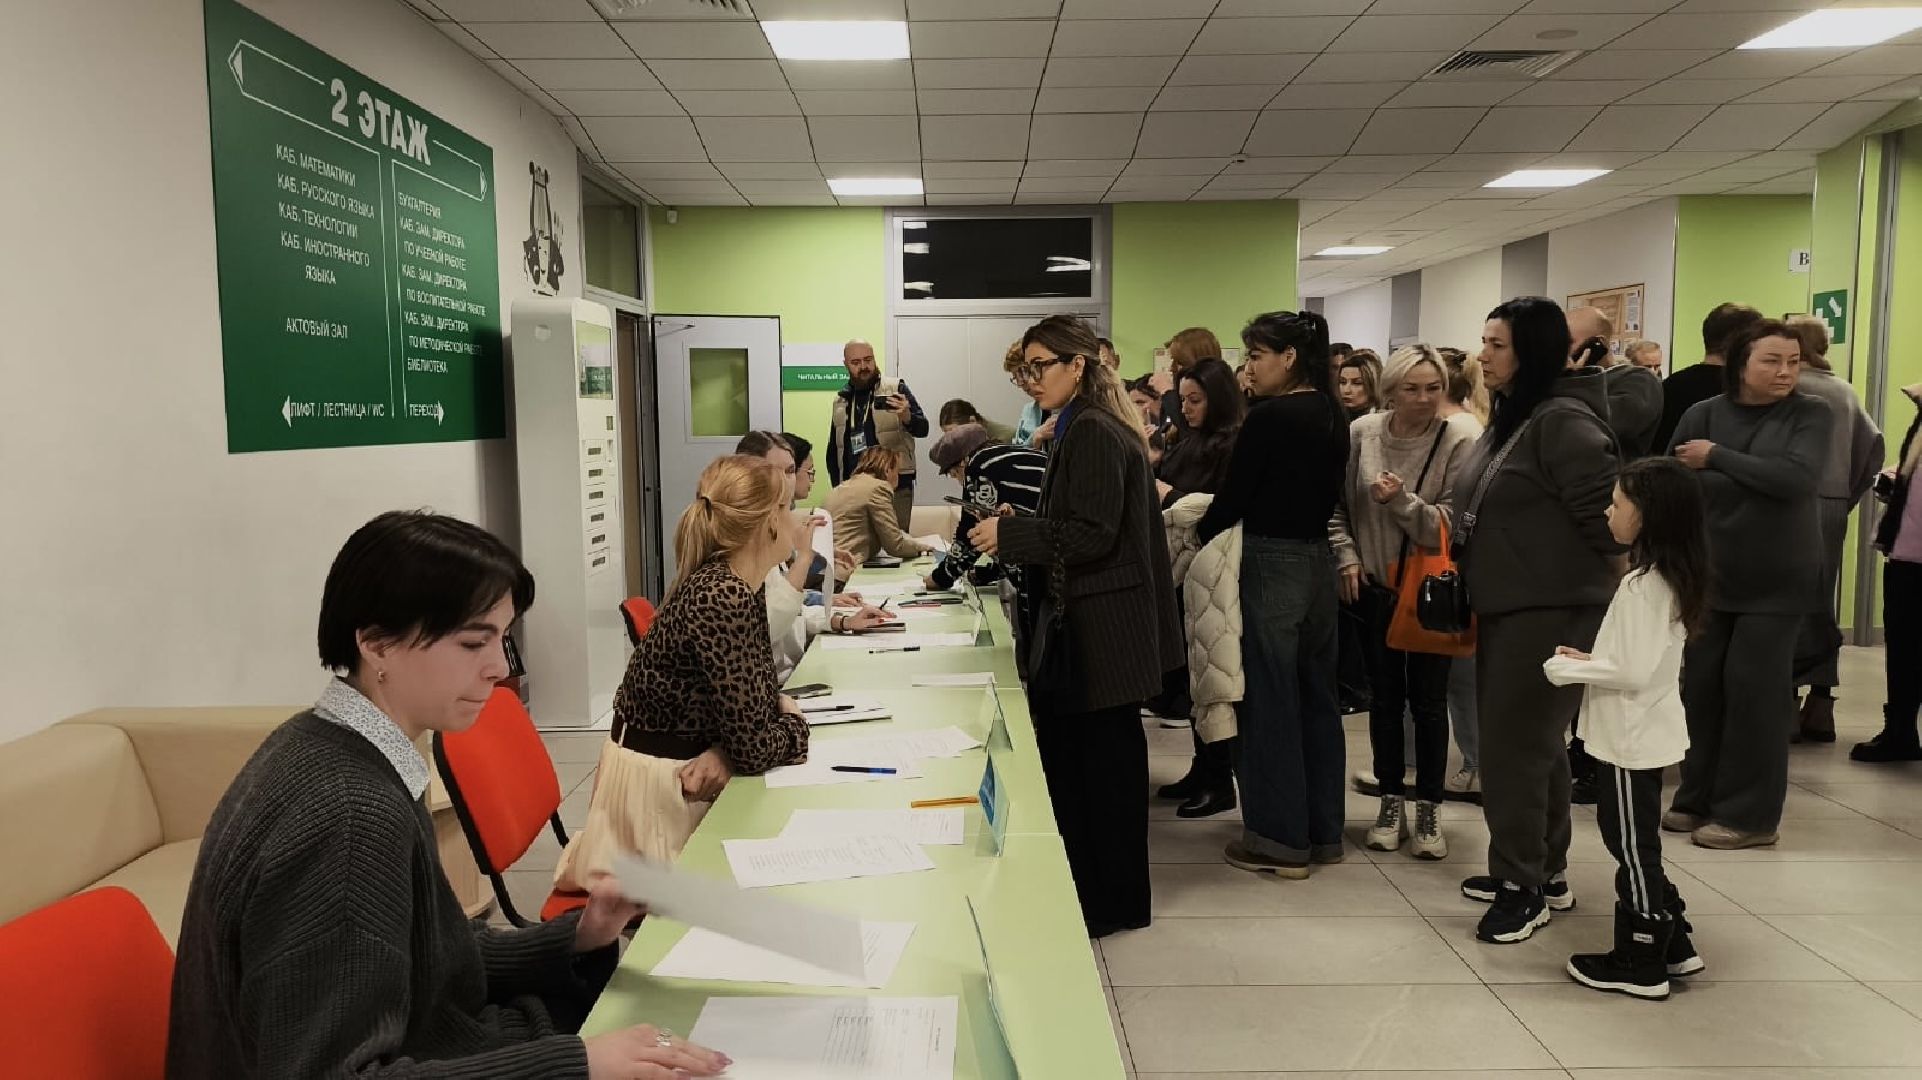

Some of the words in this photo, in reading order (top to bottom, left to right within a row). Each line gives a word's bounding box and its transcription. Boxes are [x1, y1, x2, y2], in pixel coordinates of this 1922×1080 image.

[330, 78, 349, 128] 2
[357, 90, 431, 166] ЭТАЖ
[276, 143, 298, 166] КАБ.
[300, 152, 356, 188] МАТЕМАТИКИ
[277, 172, 300, 194] КАБ.
[301, 181, 346, 210] РУССКОГО
[347, 197, 375, 219] ЯЗЫКА
[279, 201, 301, 222] КАБ.
[301, 209, 358, 240] ТЕХНОЛОГИИ
[281, 230, 302, 250] КАБ.
[304, 236, 370, 267] ИНОСТРАННОГО
[305, 264, 337, 285] ЯЗЫКА
[286, 317, 330, 338] АКТОВЫЙ
[331, 322, 348, 340] ЗАЛ
[290, 402, 316, 418] ЛИФТ
[323, 402, 366, 421] ЛЕСТНИЦА
[372, 403, 385, 417] WC
